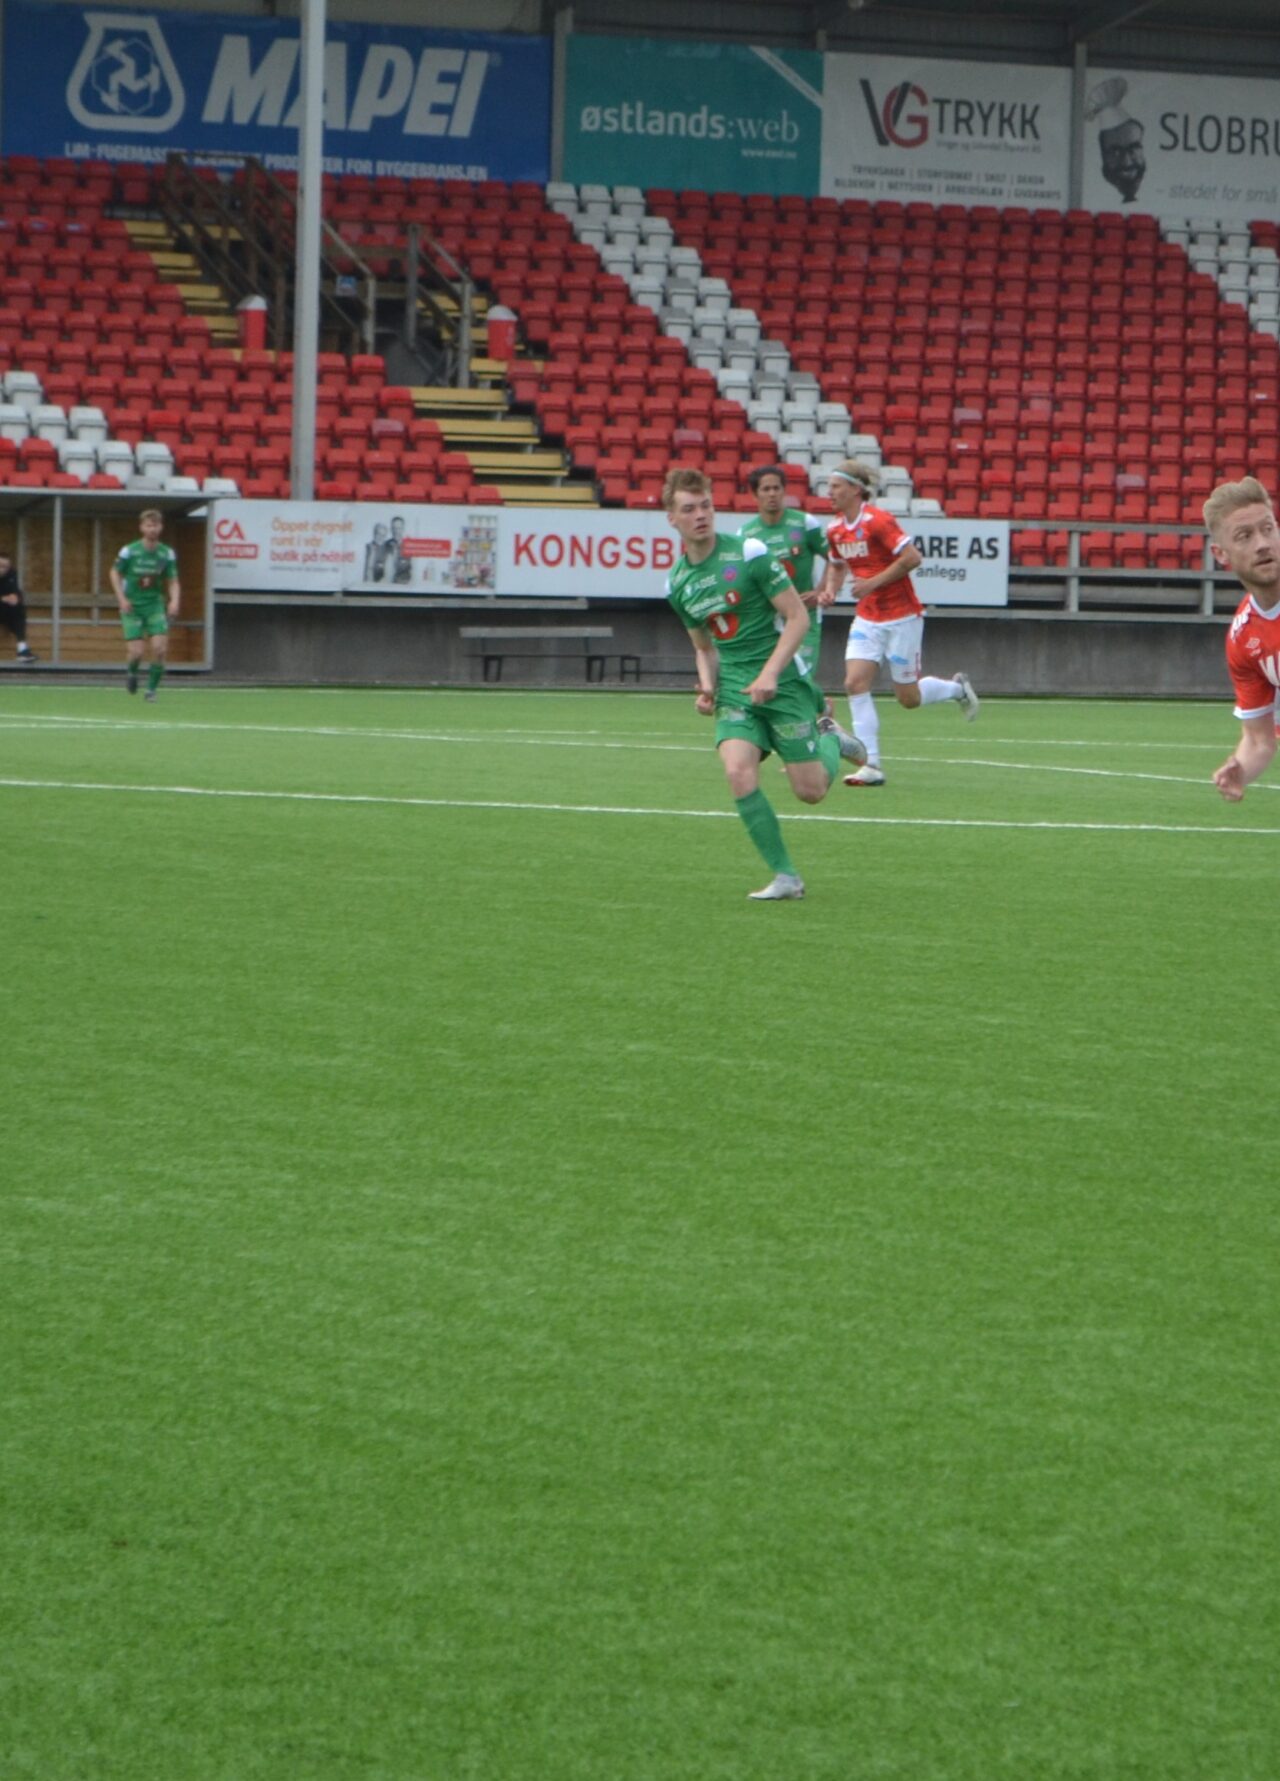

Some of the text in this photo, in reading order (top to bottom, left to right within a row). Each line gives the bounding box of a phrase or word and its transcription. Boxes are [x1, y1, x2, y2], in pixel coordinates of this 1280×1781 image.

[202, 35, 490, 138] MAPEI
[1221, 186, 1242, 201] for
[967, 537, 999, 559] AS
[916, 564, 967, 581] anlegg
